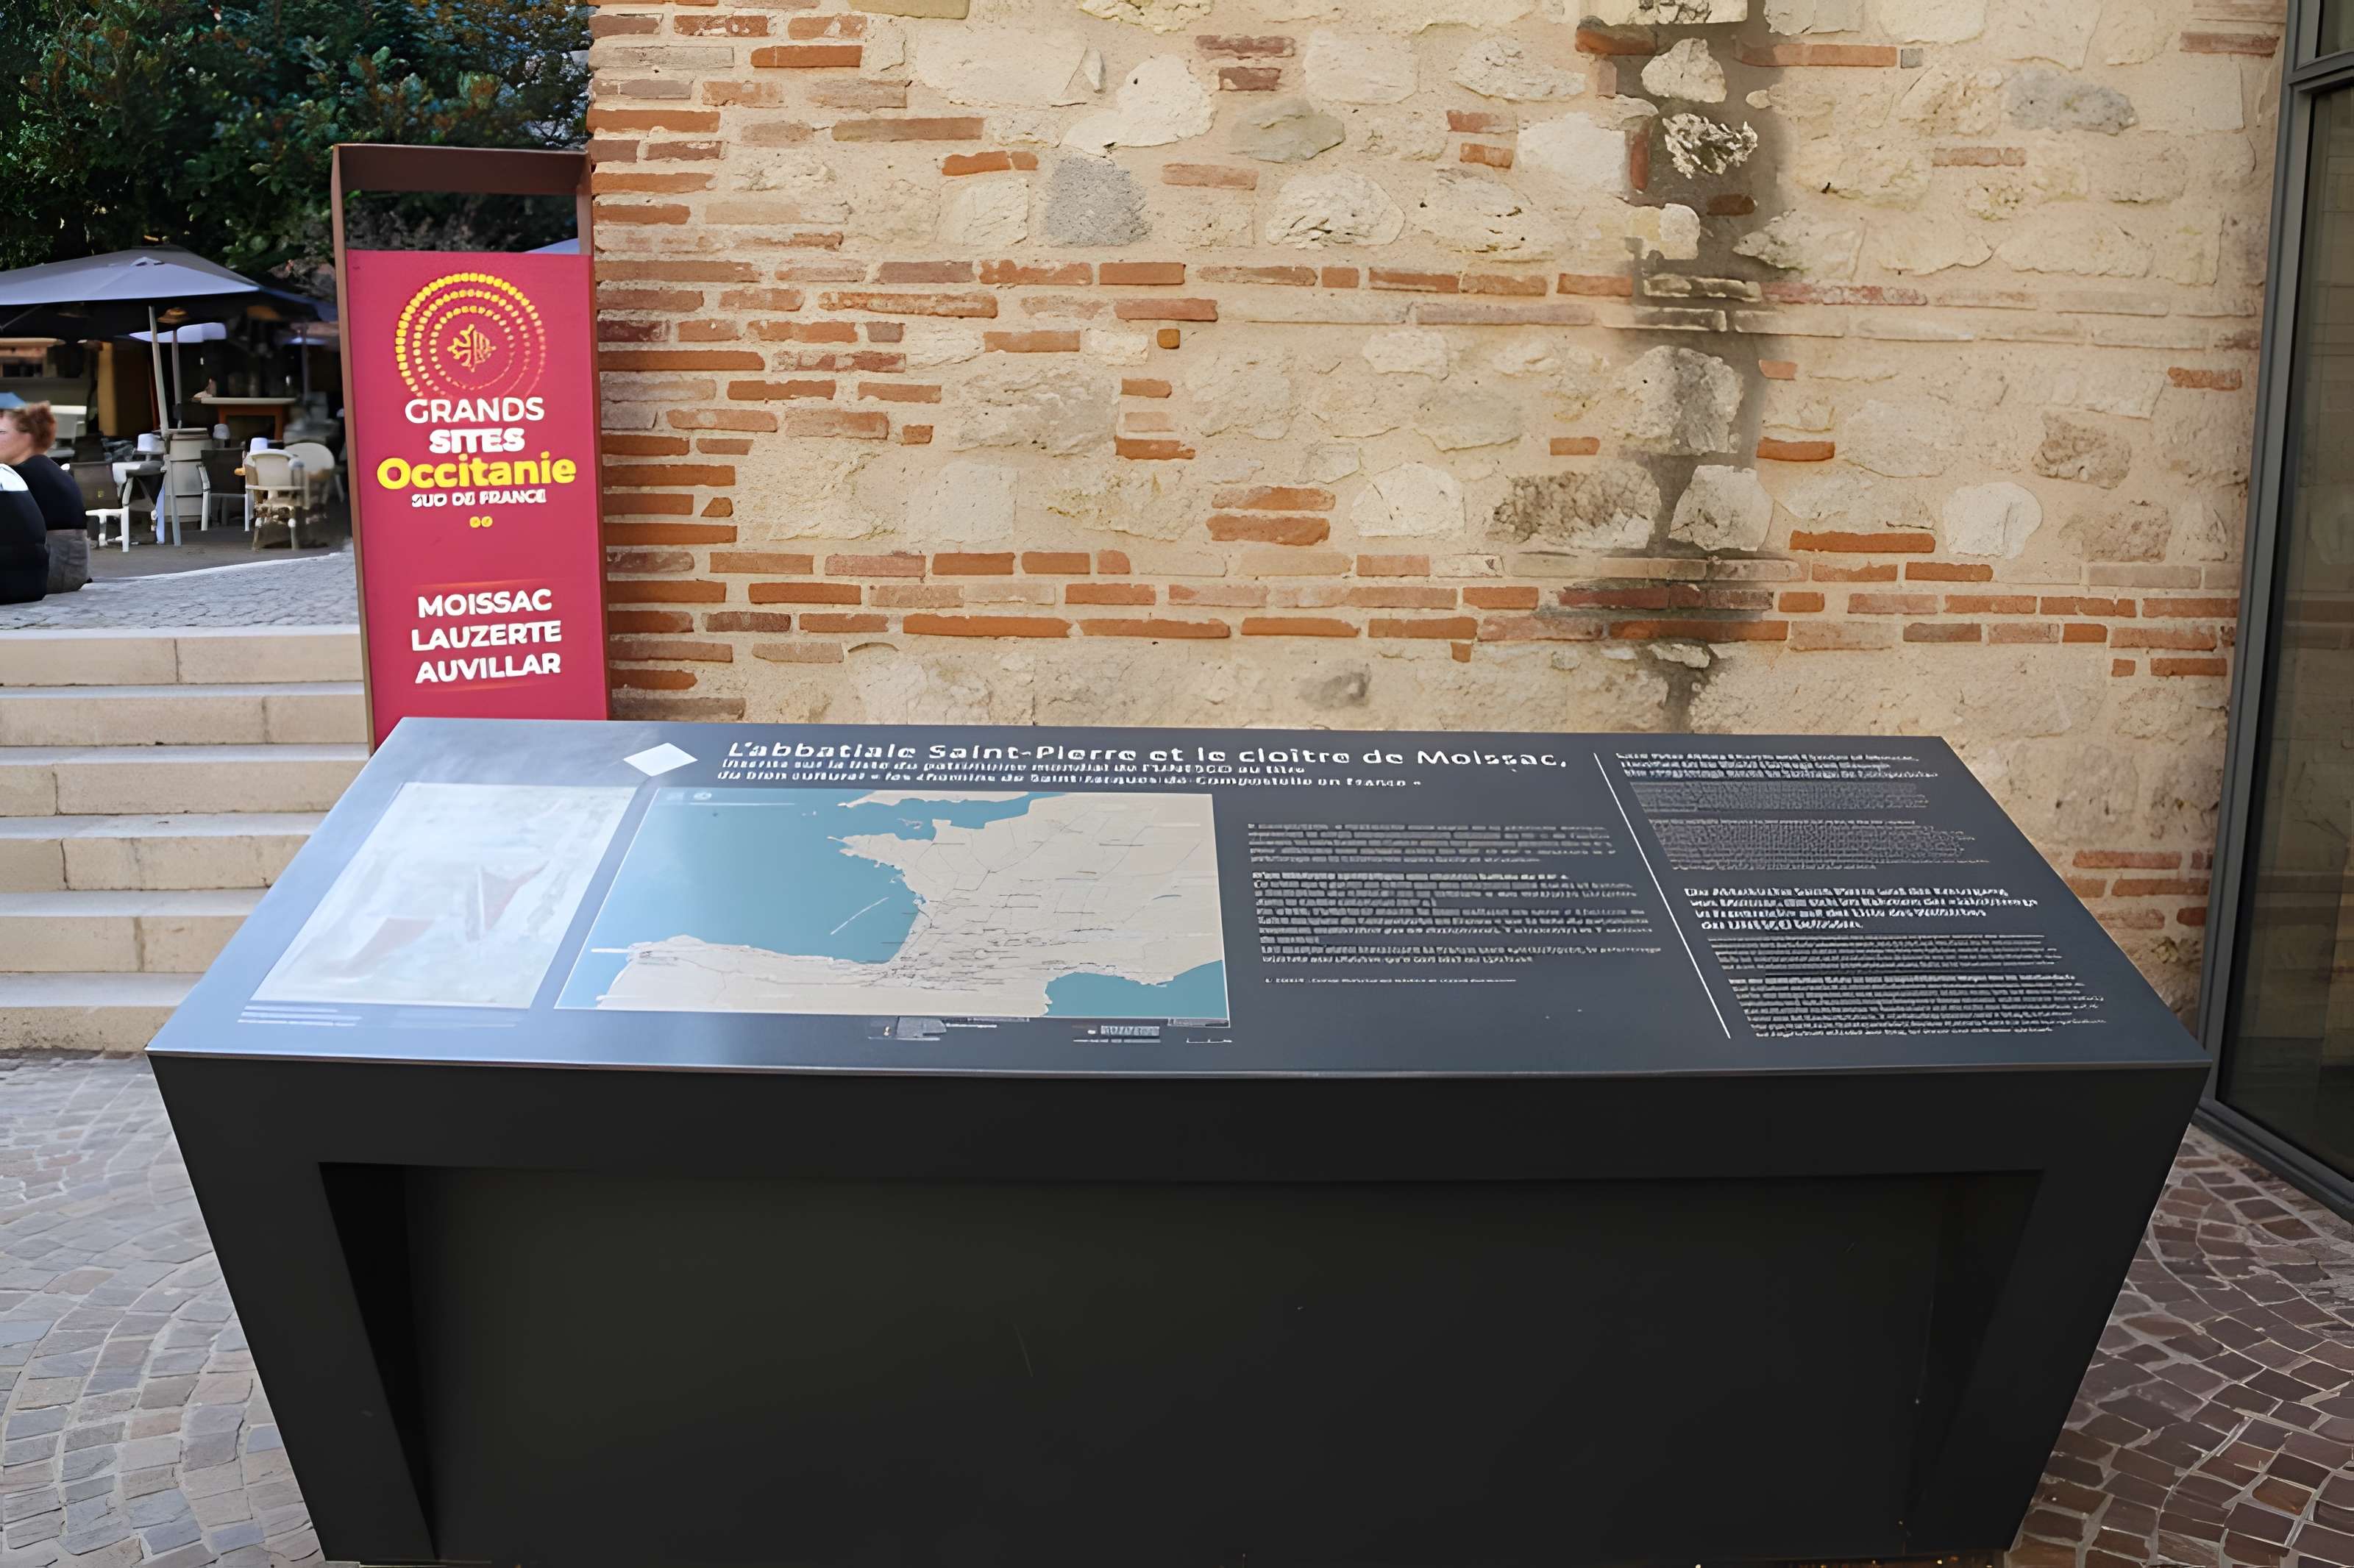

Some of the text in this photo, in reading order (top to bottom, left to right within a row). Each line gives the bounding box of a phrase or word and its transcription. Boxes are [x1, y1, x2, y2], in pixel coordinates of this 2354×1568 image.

[405, 397, 545, 424] GRANDS
[429, 427, 525, 454] SITES
[377, 451, 577, 489] Occitanie
[411, 493, 447, 507] SUD
[418, 589, 552, 618] MOISSAC
[411, 620, 562, 651] LAUZERTE
[415, 652, 561, 683] AUVILLAR
[728, 741, 916, 758] L'abbatiale
[928, 744, 1137, 760] Saint-Pierre
[1149, 747, 1184, 761] et
[1198, 747, 1226, 762] le
[1238, 747, 1351, 763] cloître
[1362, 749, 1404, 764] de
